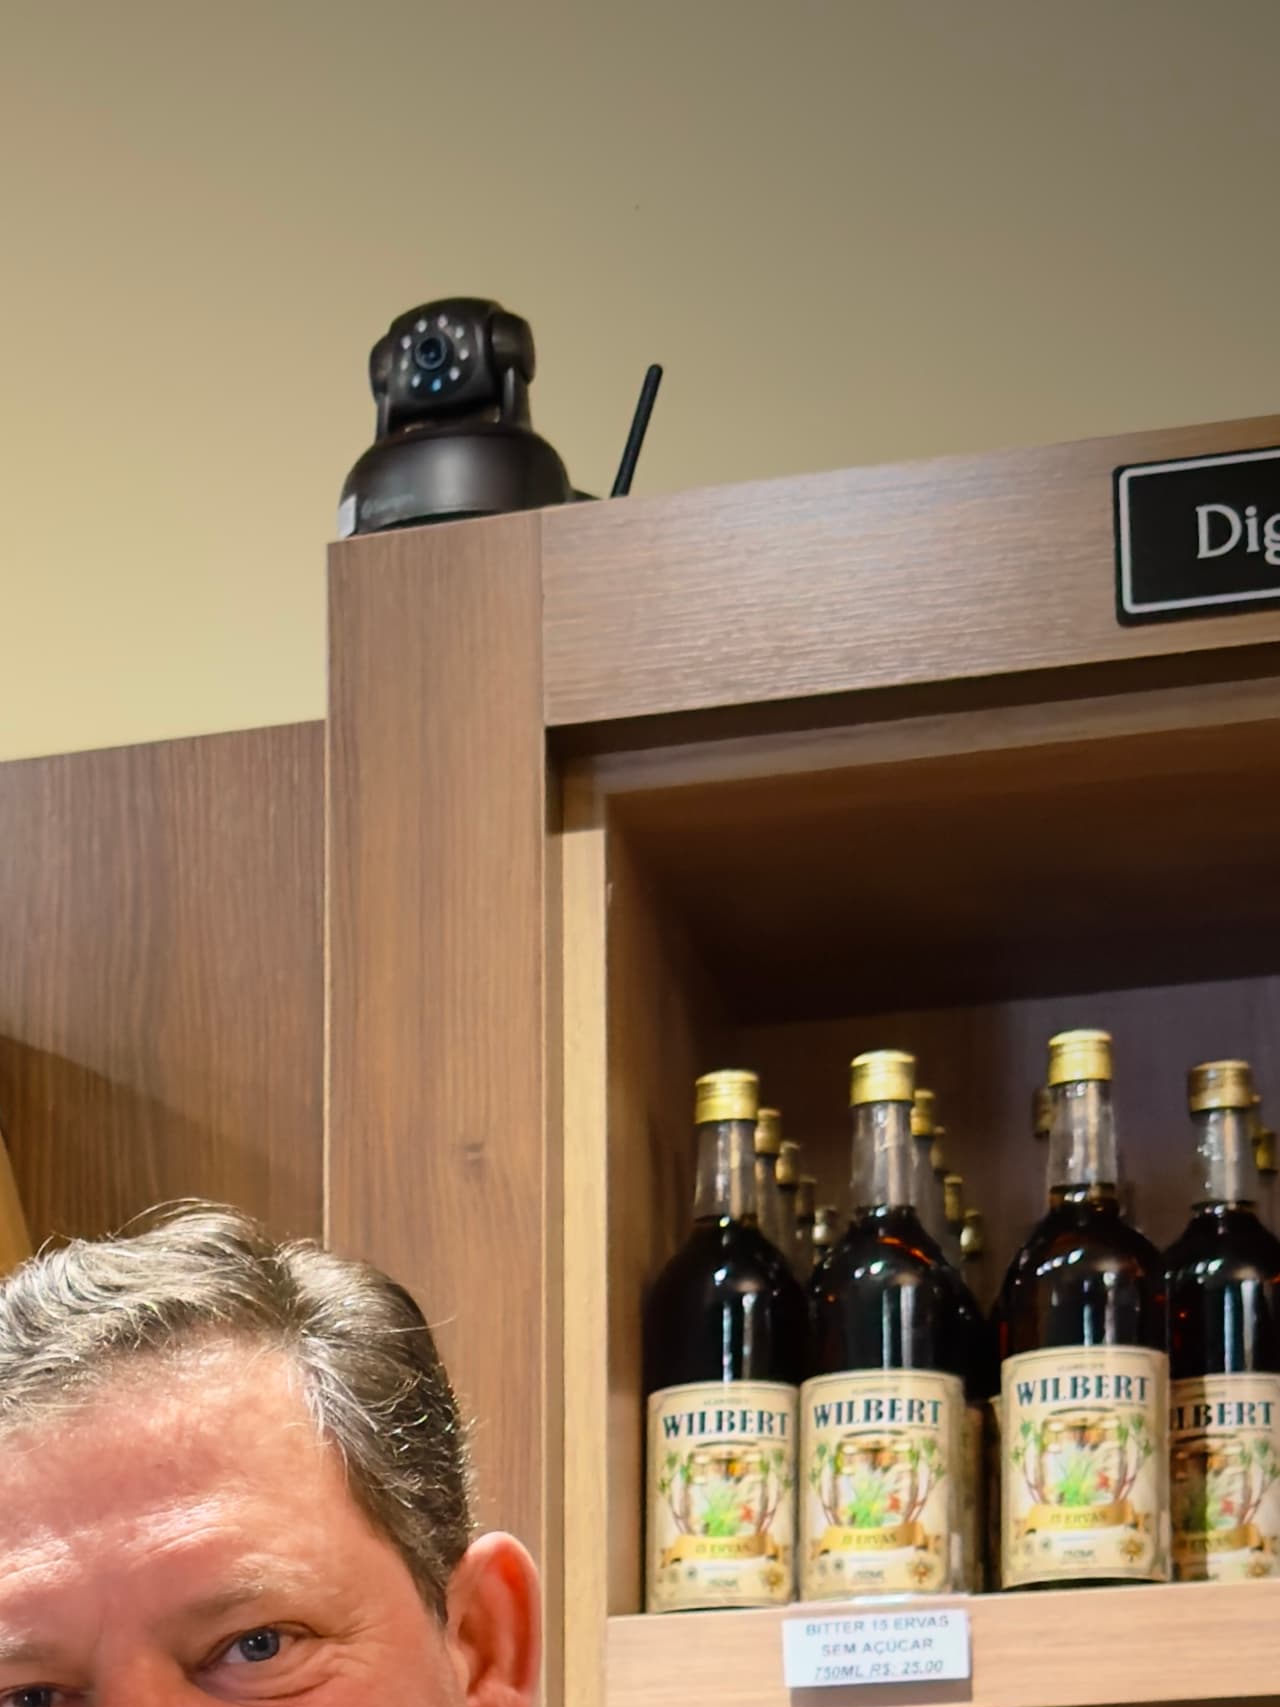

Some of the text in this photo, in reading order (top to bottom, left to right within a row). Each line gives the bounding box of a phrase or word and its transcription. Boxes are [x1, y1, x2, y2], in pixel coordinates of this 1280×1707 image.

[1017, 1375, 1149, 1405] WILBERT
[662, 1410, 788, 1439] WILBERT
[814, 1398, 943, 1429] WILBERT
[805, 1615, 949, 1636] BITTER 15 ERVAS
[821, 1643, 856, 1657] SEM
